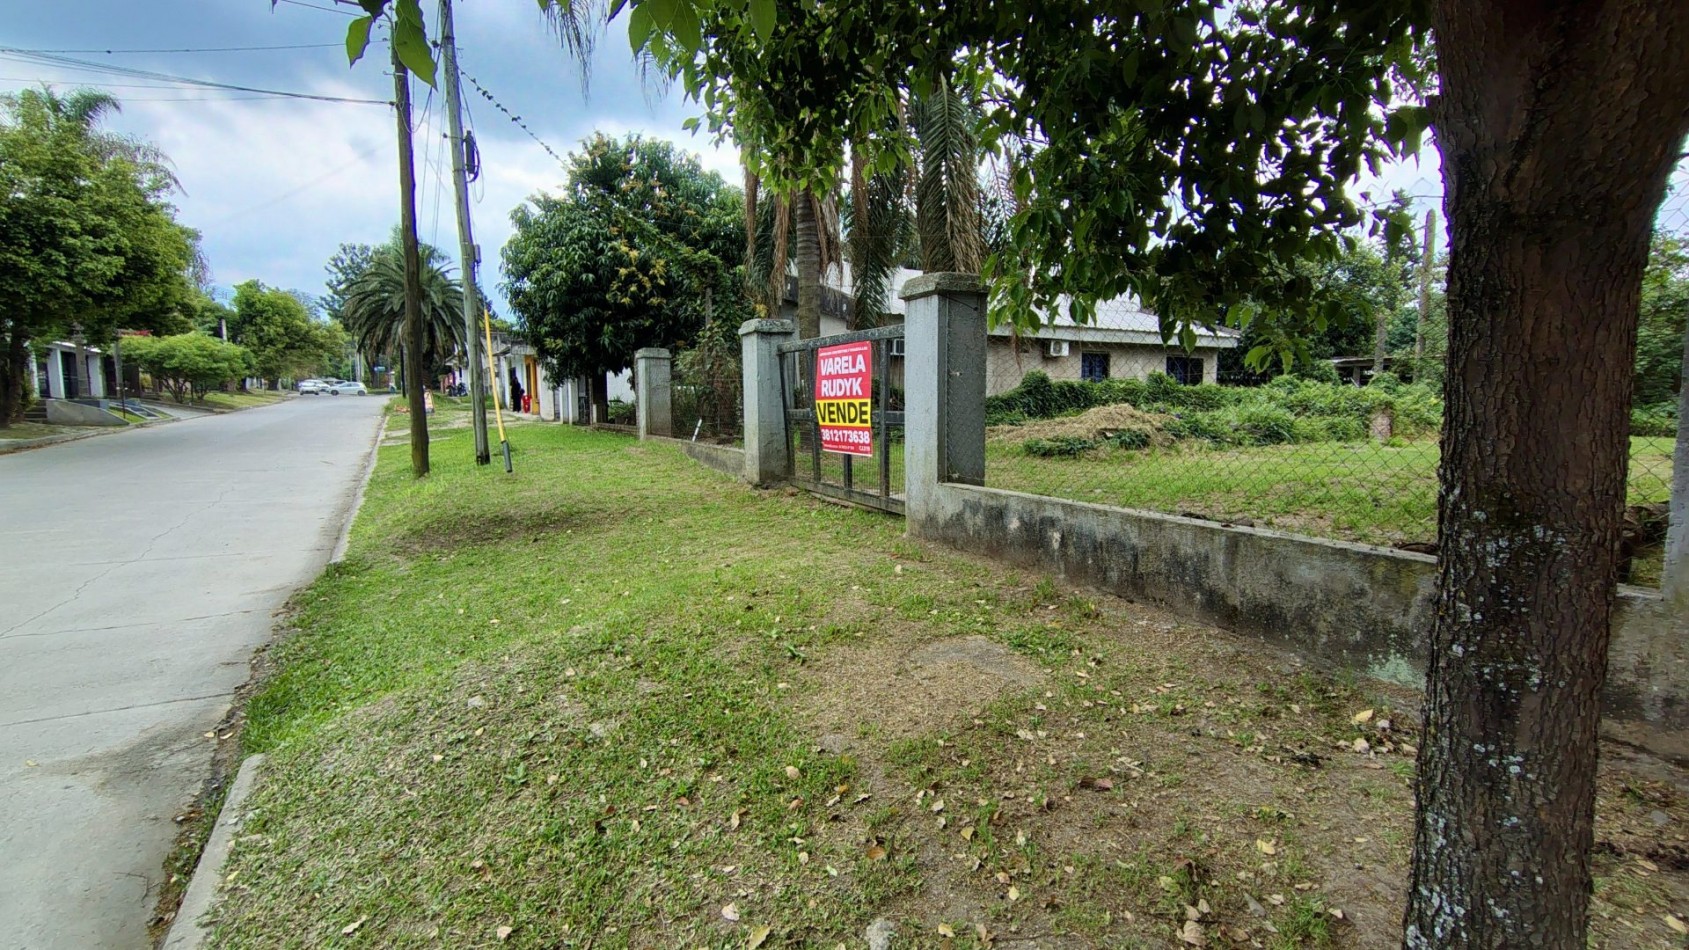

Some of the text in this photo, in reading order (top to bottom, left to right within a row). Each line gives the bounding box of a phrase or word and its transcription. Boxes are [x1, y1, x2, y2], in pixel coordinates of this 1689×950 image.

[821, 354, 866, 376] VARELA
[821, 377, 862, 397] RUDYK
[817, 402, 868, 424] VENDE
[821, 428, 871, 444] 3812173638
